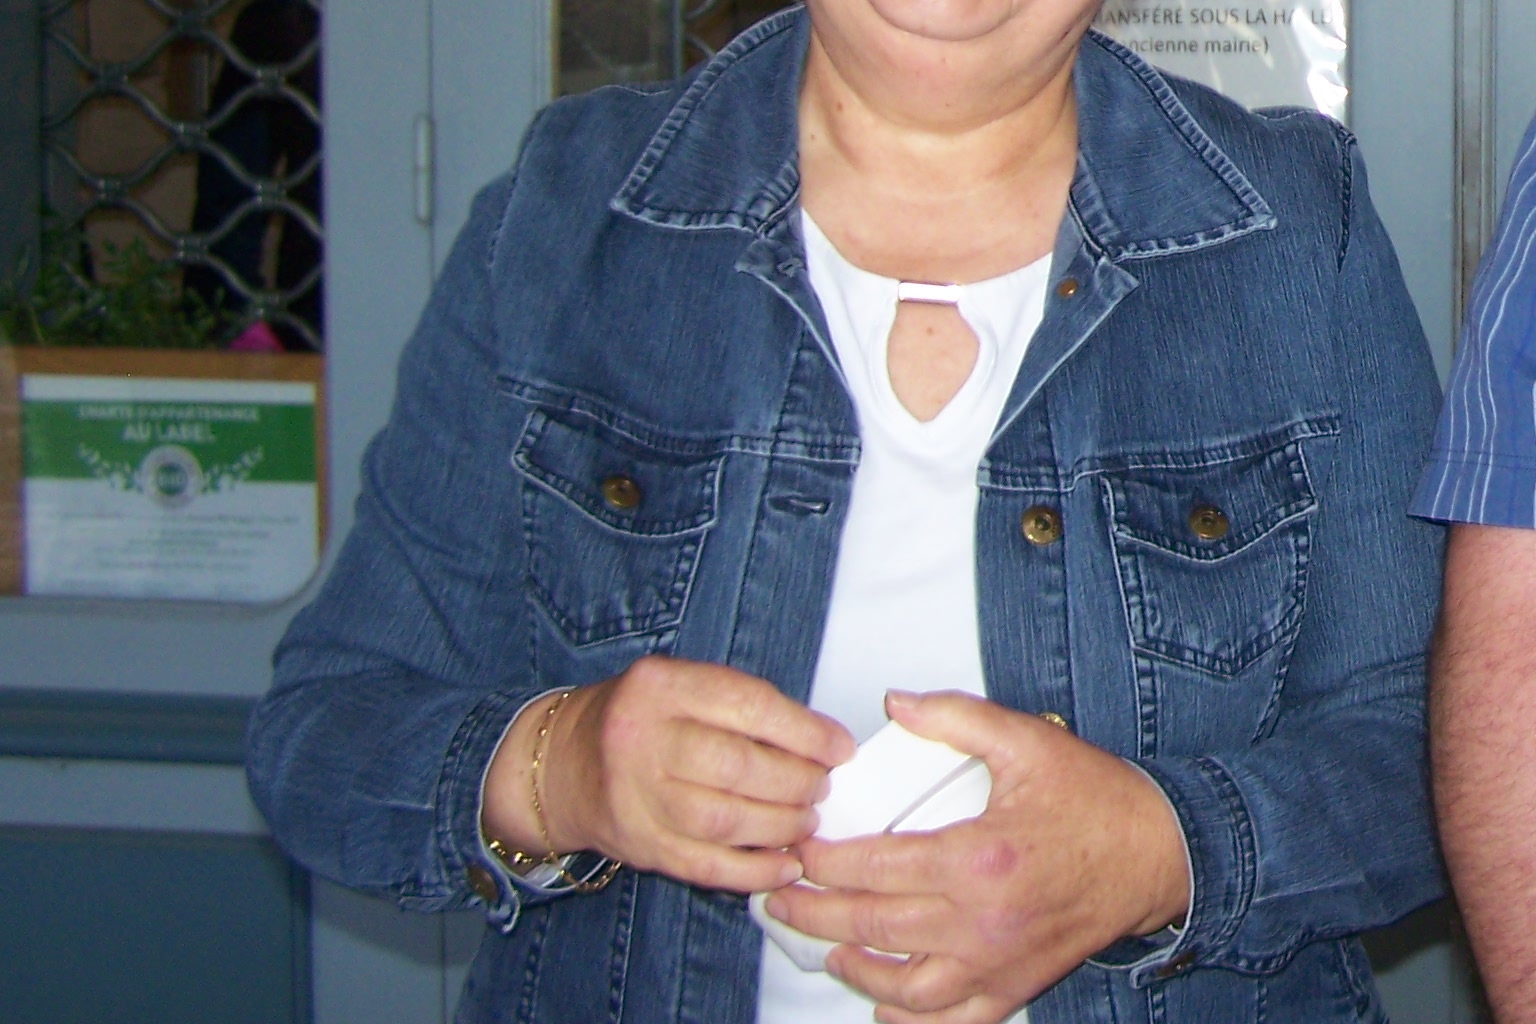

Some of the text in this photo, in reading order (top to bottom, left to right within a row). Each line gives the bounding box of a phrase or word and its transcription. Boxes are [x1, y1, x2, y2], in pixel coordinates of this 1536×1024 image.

[1190, 8, 1240, 26] SOUS
[1246, 9, 1268, 25] LA
[1126, 36, 1199, 54] ncienne
